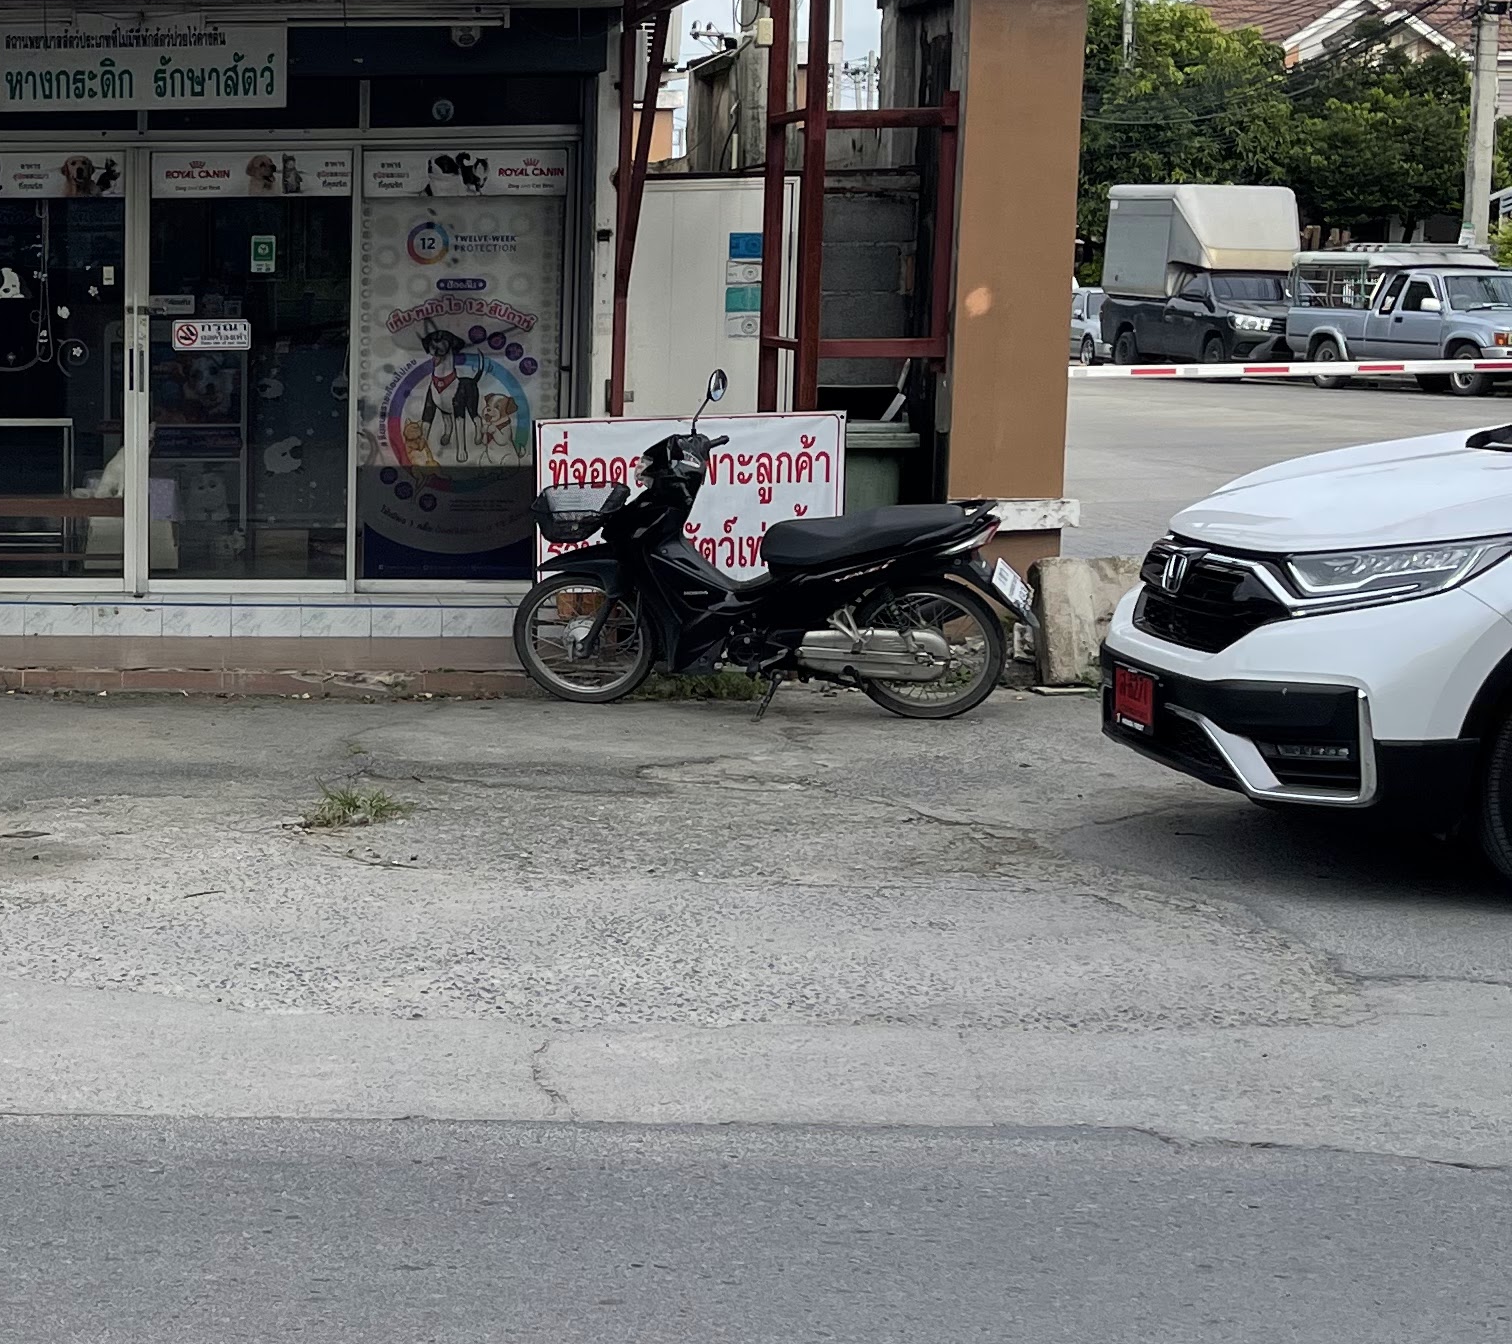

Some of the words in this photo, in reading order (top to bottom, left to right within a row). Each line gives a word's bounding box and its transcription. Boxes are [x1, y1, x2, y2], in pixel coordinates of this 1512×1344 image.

[5, 58, 133, 99] หางกระดิก
[153, 52, 275, 97] รักษาสัตว์
[166, 170, 195, 179] ROYAL
[198, 170, 230, 178] CANIN
[498, 168, 529, 176] ROYAL
[532, 168, 564, 176] CANIN
[420, 238, 435, 249] 12
[454, 244, 516, 252] PROTECTION
[468, 301, 484, 312] 12
[201, 324, 247, 335] กรุณา
